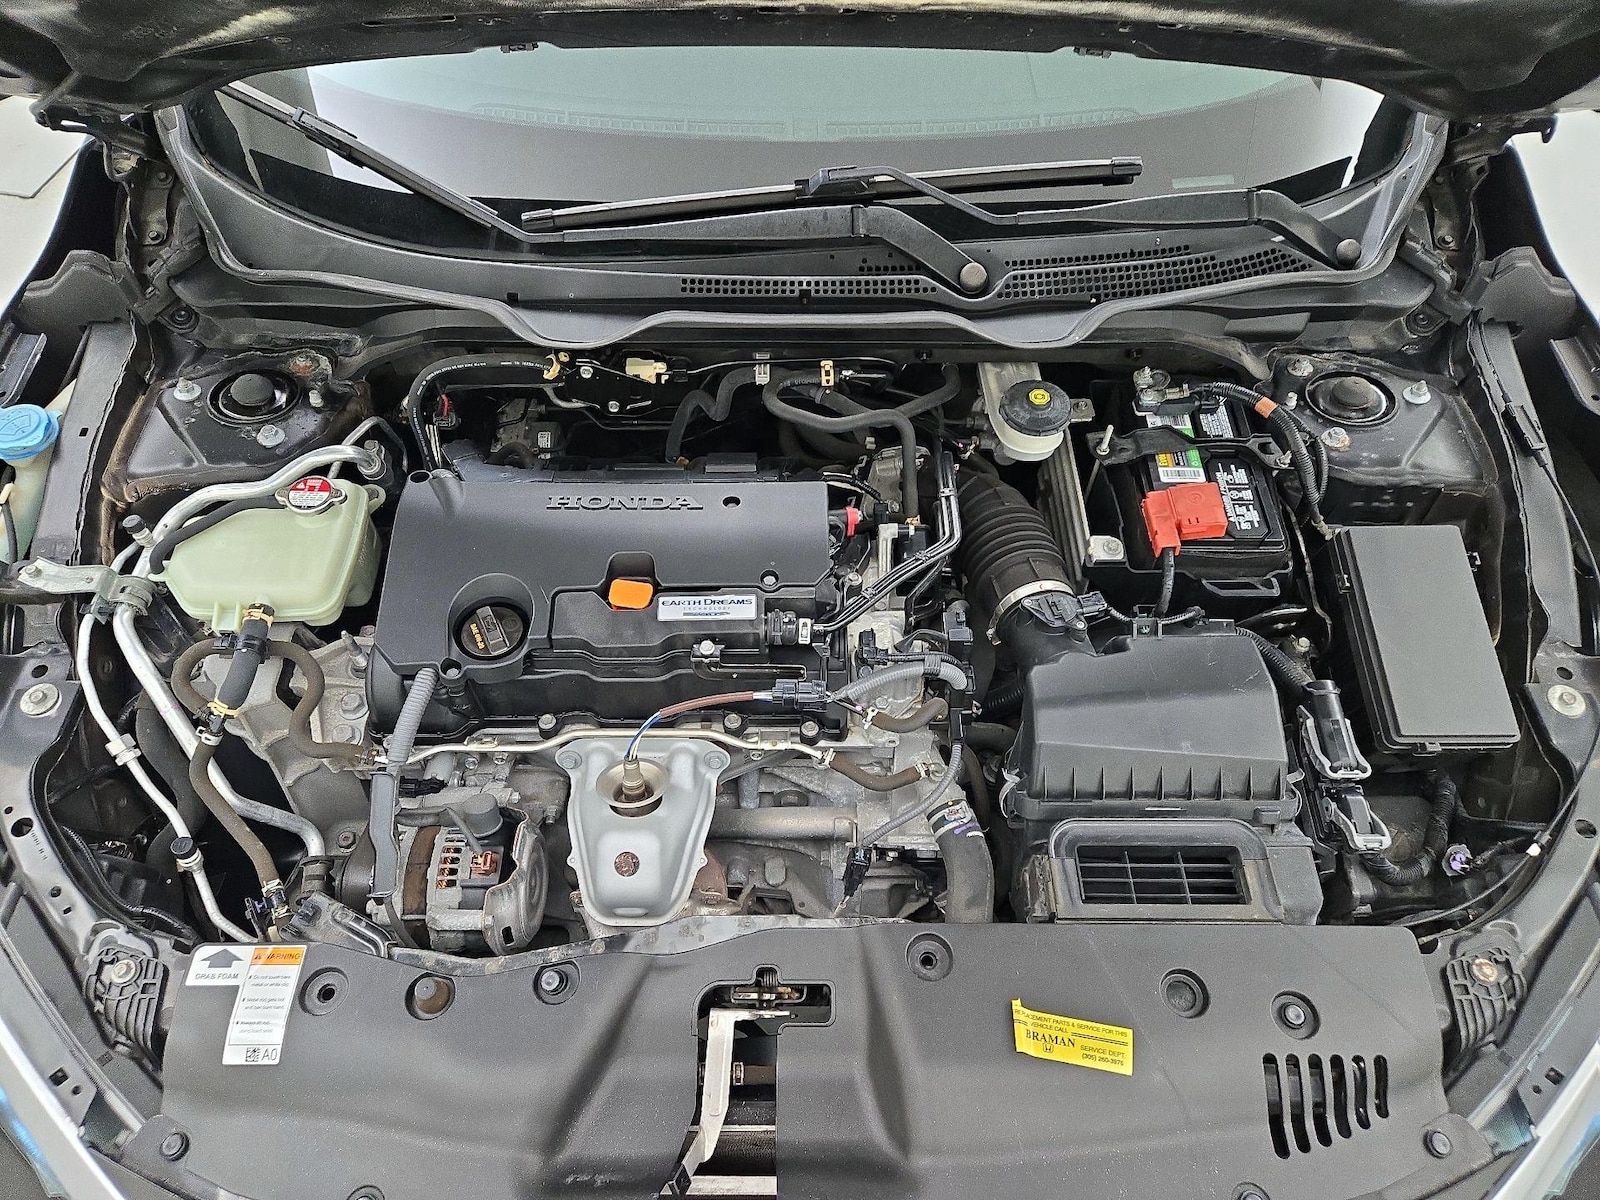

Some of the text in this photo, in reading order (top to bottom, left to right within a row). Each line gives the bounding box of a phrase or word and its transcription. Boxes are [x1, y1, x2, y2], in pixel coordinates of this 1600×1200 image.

[546, 495, 703, 510] HONDA
[263, 951, 300, 959] WARNING
[1014, 1009, 1051, 1023] REPLACEMENT
[1053, 1019, 1070, 1027] PARTS
[1077, 1023, 1101, 1033] SERVICE
[1026, 1029, 1076, 1048] BRAMAN
[1080, 1045, 1107, 1055] SERVICE
